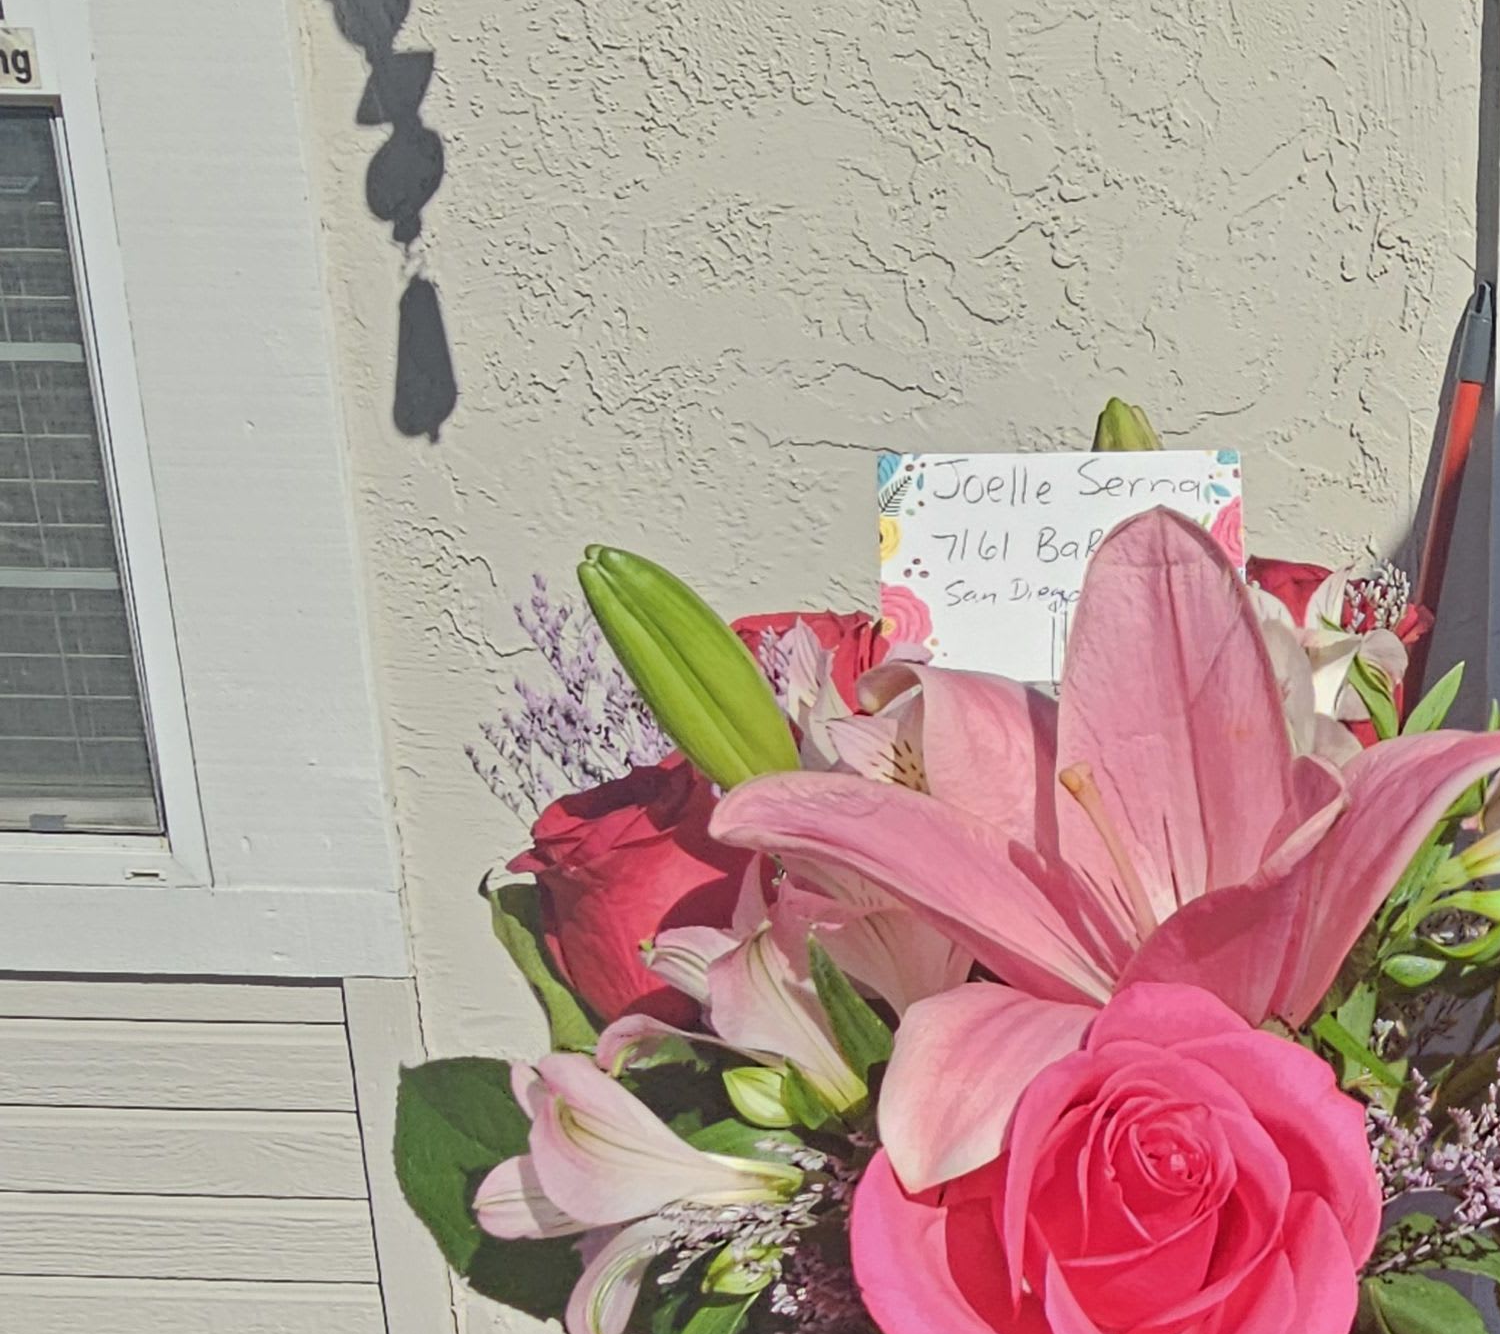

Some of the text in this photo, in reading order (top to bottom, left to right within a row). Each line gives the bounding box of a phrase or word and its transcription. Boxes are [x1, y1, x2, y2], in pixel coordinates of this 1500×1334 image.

[933, 458, 1052, 505] Joelle
[932, 528, 1009, 562] 7161
[945, 579, 997, 607] San
